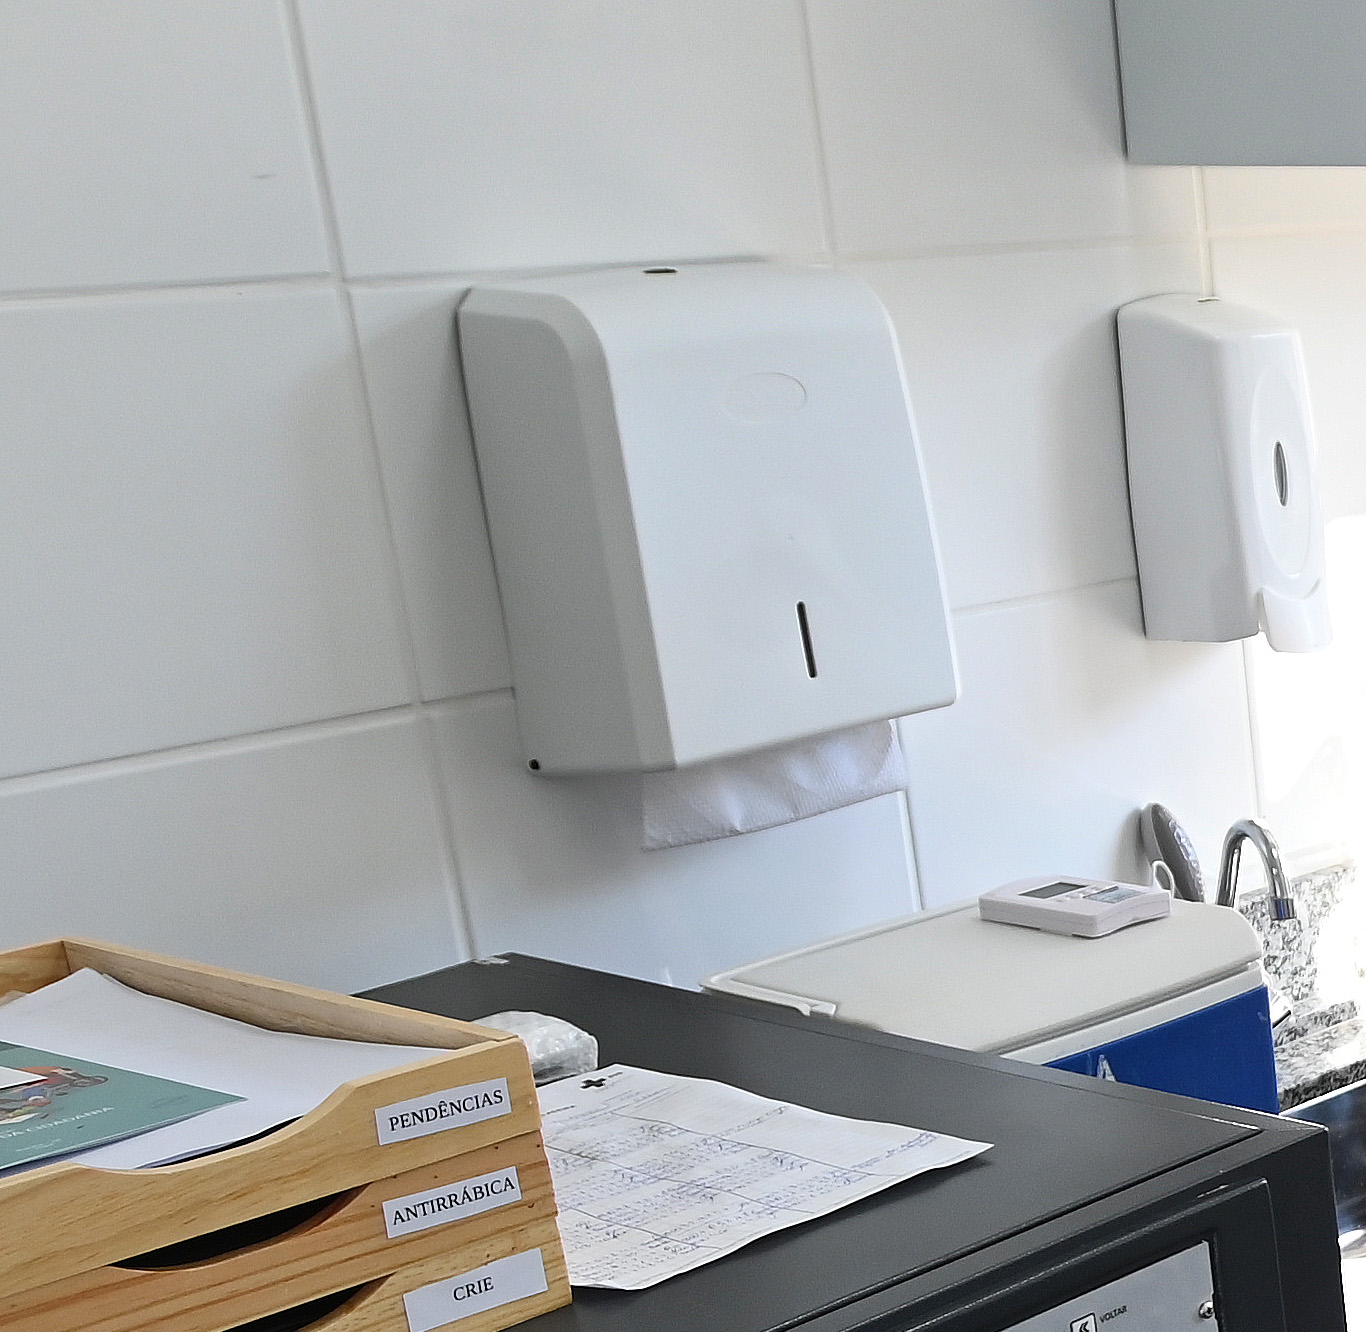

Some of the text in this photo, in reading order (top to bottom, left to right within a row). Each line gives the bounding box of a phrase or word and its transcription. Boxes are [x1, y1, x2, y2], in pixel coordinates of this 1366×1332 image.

[388, 1089, 504, 1132] PENDÊNCIAS
[392, 1175, 516, 1226] ANTIRRÁBICA
[452, 1276, 494, 1302] CRIE
[1099, 1305, 1127, 1323] VOLTAR
